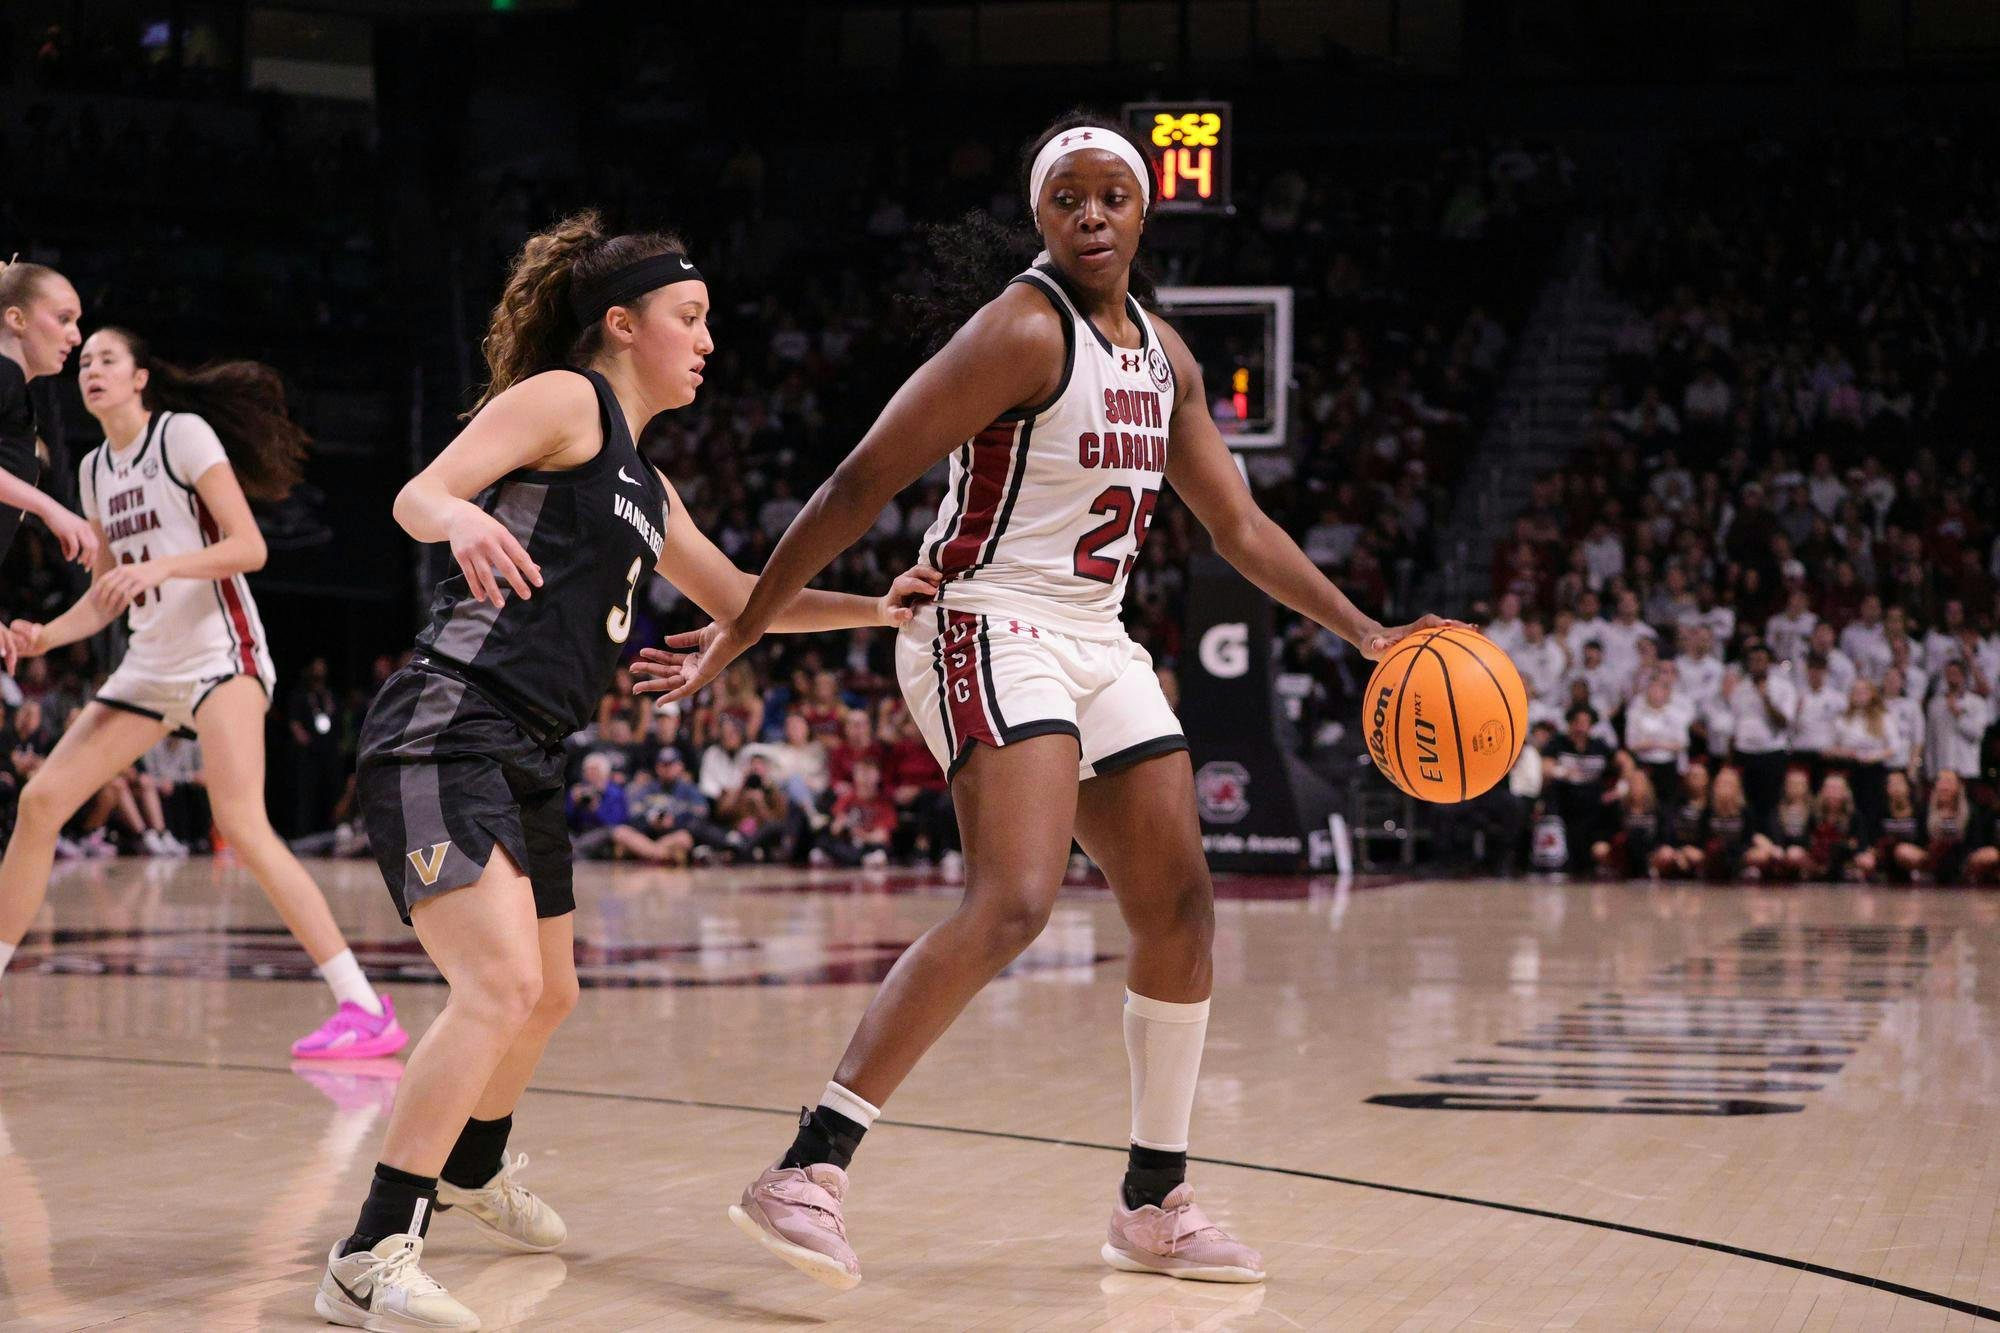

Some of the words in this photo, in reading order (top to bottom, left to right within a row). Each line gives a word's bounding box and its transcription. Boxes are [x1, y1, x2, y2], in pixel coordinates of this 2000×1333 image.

[1151, 112, 1221, 147] 2:52
[1163, 148, 1212, 199] 14
[1104, 388, 1162, 428] SOUTH
[108, 486, 145, 517] SOUTH
[606, 556, 642, 644] 3
[1199, 622, 1249, 679] G
[1414, 692, 1422, 717] NXT
[1415, 718, 1443, 783] EVO
[407, 840, 452, 886] V
